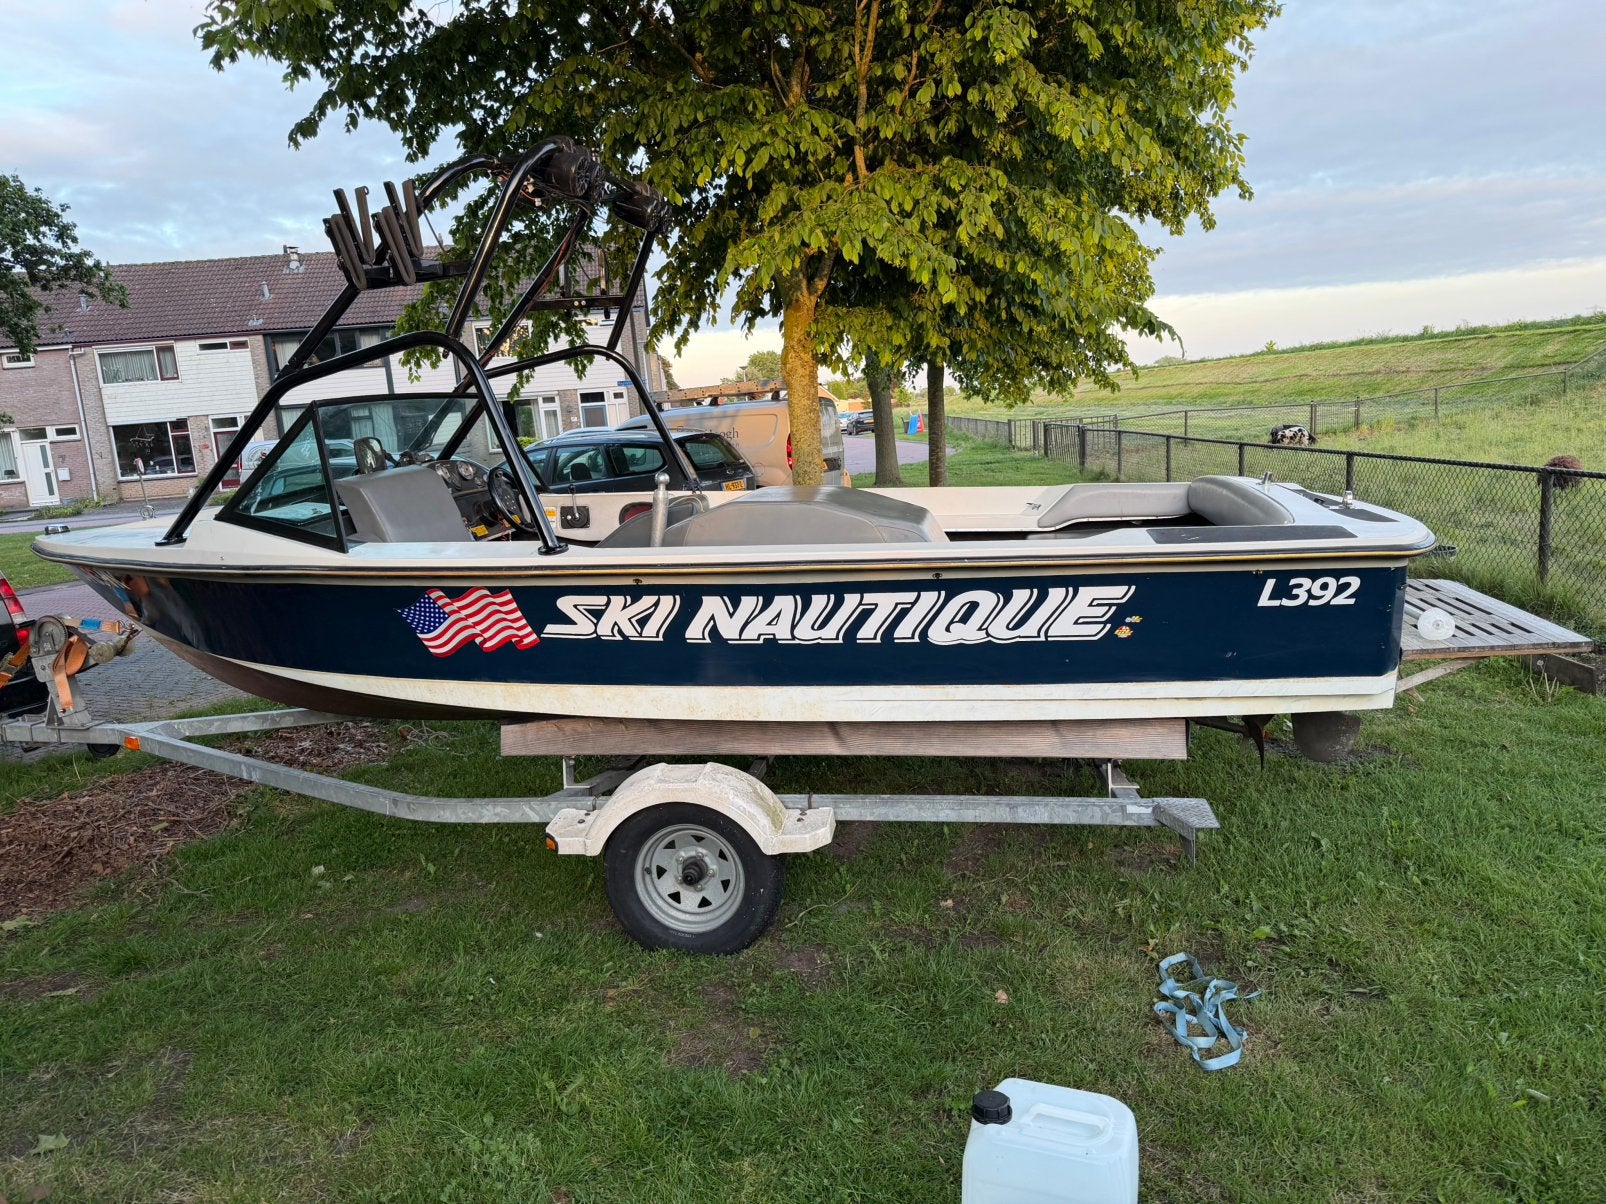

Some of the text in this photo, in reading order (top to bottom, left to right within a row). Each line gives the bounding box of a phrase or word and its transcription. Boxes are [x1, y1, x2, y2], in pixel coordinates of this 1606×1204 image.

[1257, 577, 1360, 607] L392
[541, 585, 1137, 647] SKI NAUTIQUE
